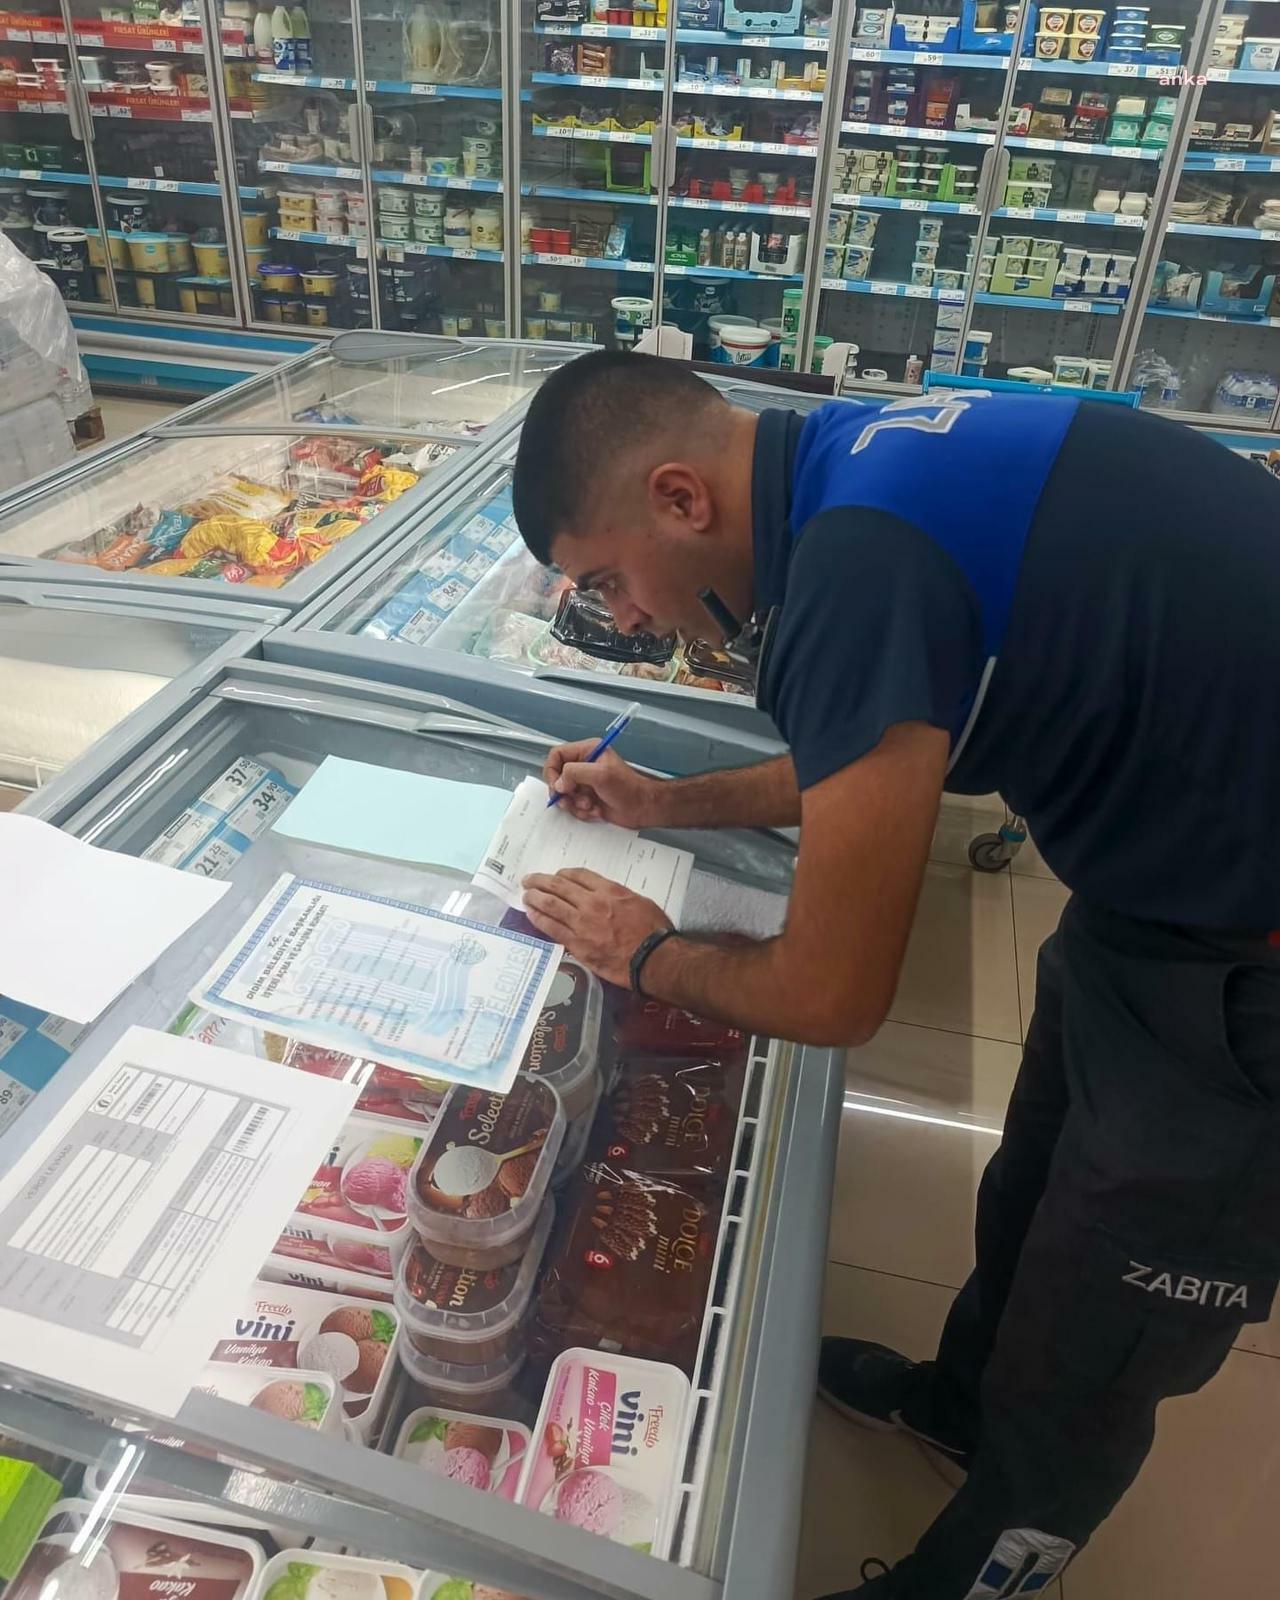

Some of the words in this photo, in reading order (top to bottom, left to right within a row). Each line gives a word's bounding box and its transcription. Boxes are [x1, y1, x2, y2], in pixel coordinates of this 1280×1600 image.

[246, 974, 266, 1000] DİDİM
[263, 934, 292, 977] BELEDİYE
[468, 1090, 506, 1144] Select
[672, 1208, 701, 1273] DOLCE
[288, 1272, 324, 1287] vini
[1121, 1260, 1248, 1309] ZABITA
[224, 1343, 268, 1356] Vanilya
[235, 1315, 296, 1341] vini
[585, 1368, 601, 1406] Kakao
[599, 1401, 612, 1432] Çilek
[611, 1390, 645, 1457] vini
[580, 1416, 597, 1466] Vanilya
[148, 1579, 196, 1596] Kakao
